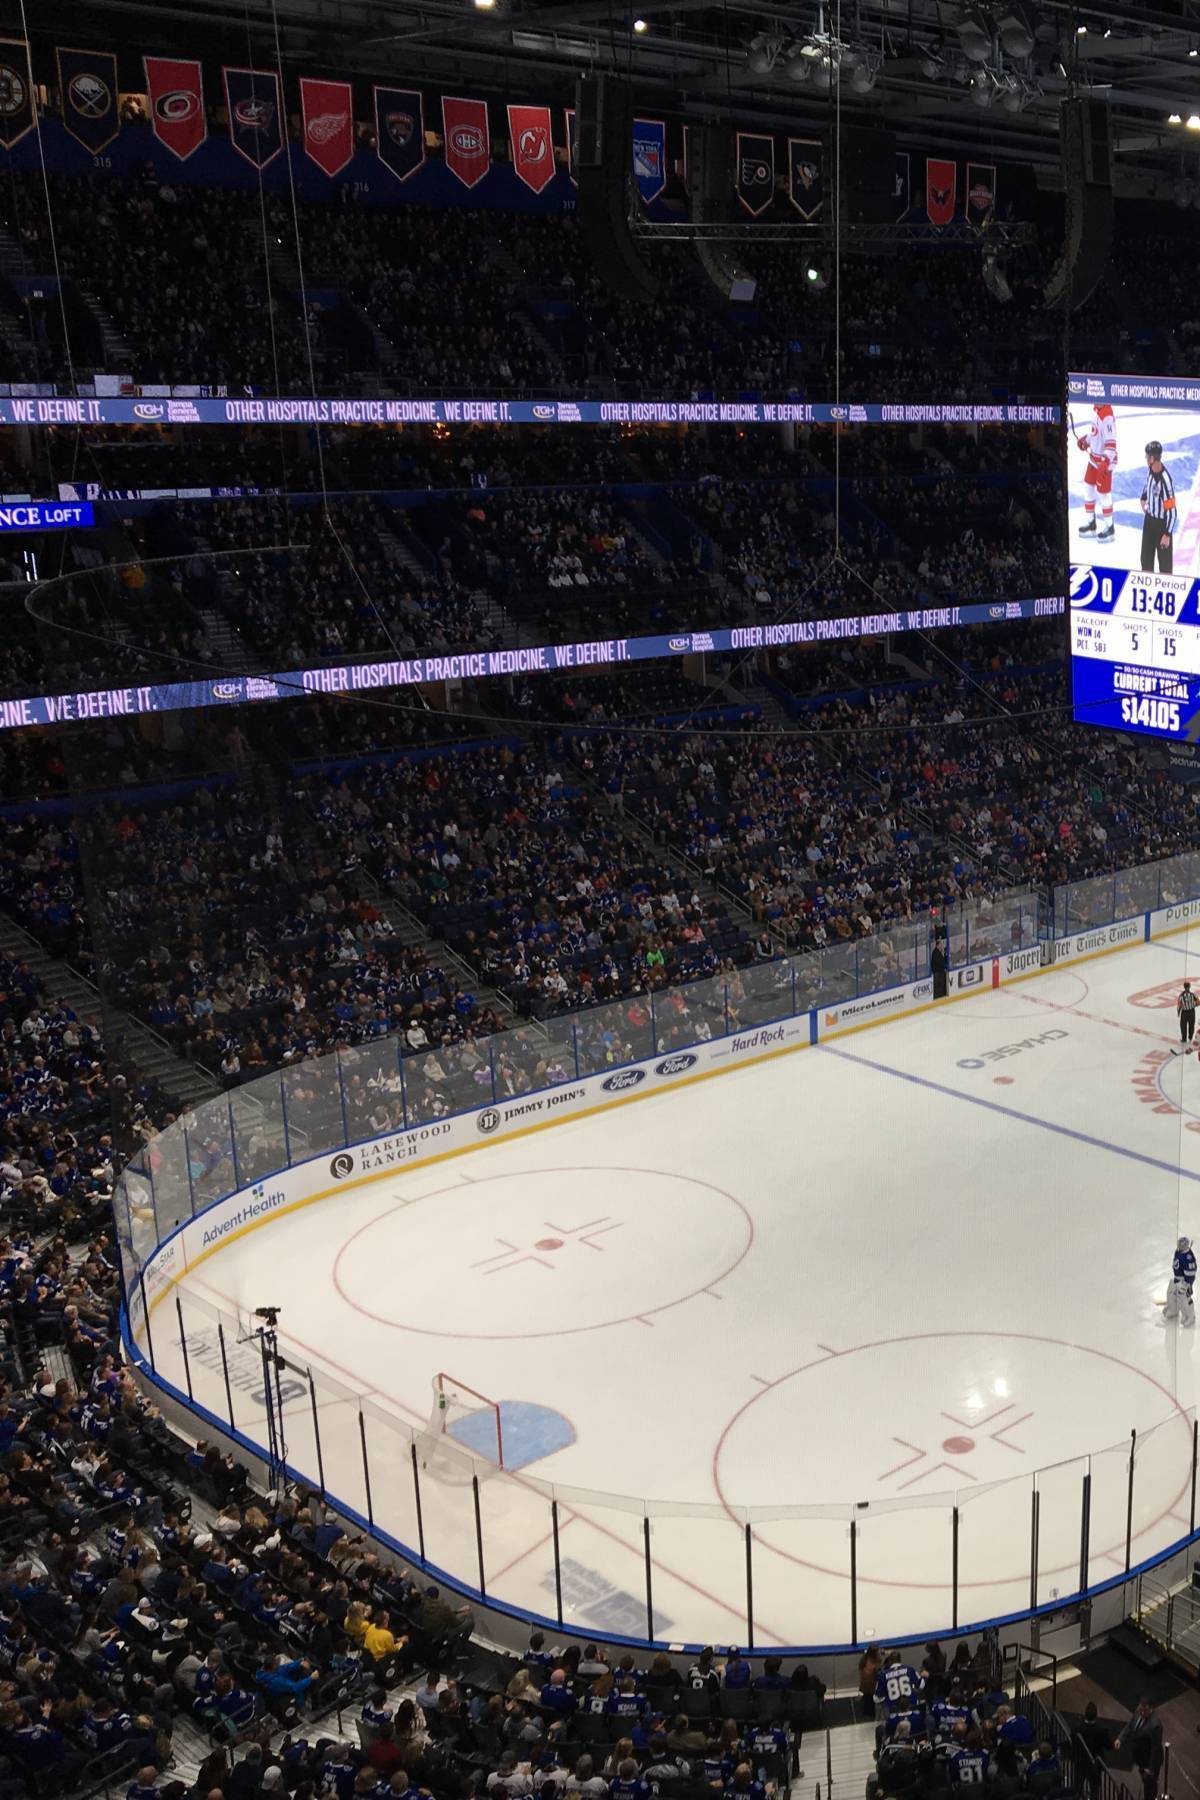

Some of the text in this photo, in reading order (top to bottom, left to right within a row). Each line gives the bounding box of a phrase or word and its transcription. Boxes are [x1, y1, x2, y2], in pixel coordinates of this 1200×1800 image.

[93, 156, 112, 168] 315
[12, 400, 106, 421] WE DEFINE IT.
[138, 404, 164, 416] TGH
[226, 401, 512, 422] OTHER HOSPITALS PRACTICE MEDICINE. WE DEFINE IT.
[601, 404, 630, 421] OTHER
[632, 404, 676, 421] HOSPITALS
[679, 404, 718, 421] PRACTICE
[720, 404, 760, 421] MEDICINE.
[764, 405, 776, 421] WE
[778, 405, 804, 421] DEFINE
[806, 405, 814, 421] IT.
[882, 405, 904, 421] OTHER
[906, 406, 940, 421] HOSPITALS
[942, 406, 972, 421] PRACTICE
[974, 406, 1004, 421] MEDICINE.
[1008, 407, 1018, 421] WE
[1019, 407, 1044, 421] DEFINE
[45, 508, 82, 523] LOFT
[1102, 578, 1112, 603] 0
[1130, 575, 1186, 590] 2ND Period
[1132, 588, 1176, 616] 13:48
[732, 626, 762, 649] OTHER
[766, 621, 814, 645] HOSPITALS
[817, 616, 859, 640] PRACTICE
[862, 612, 904, 635] MEDICINE.
[908, 610, 923, 629] WE
[923, 608, 950, 628] DEFINE
[952, 608, 962, 625] IT.
[1077, 617, 1108, 626] FACEOFF
[1078, 626, 1092, 638] WON
[1123, 623, 1148, 632] SHOTS
[1132, 632, 1139, 651] 5
[1158, 628, 1183, 638] SHOTS
[1164, 637, 1176, 656] 15
[302, 667, 349, 694] OTHER
[352, 660, 422, 689] HOSPITALS
[426, 653, 486, 680] PRACTICE
[489, 647, 550, 674] MEDICINE.
[555, 644, 574, 667] WE
[577, 640, 614, 665] DEFINE
[618, 640, 630, 660] IT.
[1140, 668, 1154, 676] CASH
[1154, 670, 1180, 680] DRAWING
[1114, 672, 1189, 700] CURRENT TOTAL
[45, 686, 156, 722] WE DEFINE IT.
[1122, 696, 1180, 732] $14105
[732, 1026, 785, 1054] Hard Rock
[981, 1028, 1070, 1062] CHASE
[504, 1088, 586, 1122] JIMMY JOHN'S
[360, 1123, 452, 1158] LAKEWOOD
[362, 1146, 418, 1170] RANCH
[201, 1190, 286, 1247] AdventHealth
[886, 1676, 912, 1700] 86
[960, 1766, 982, 1784] 91
